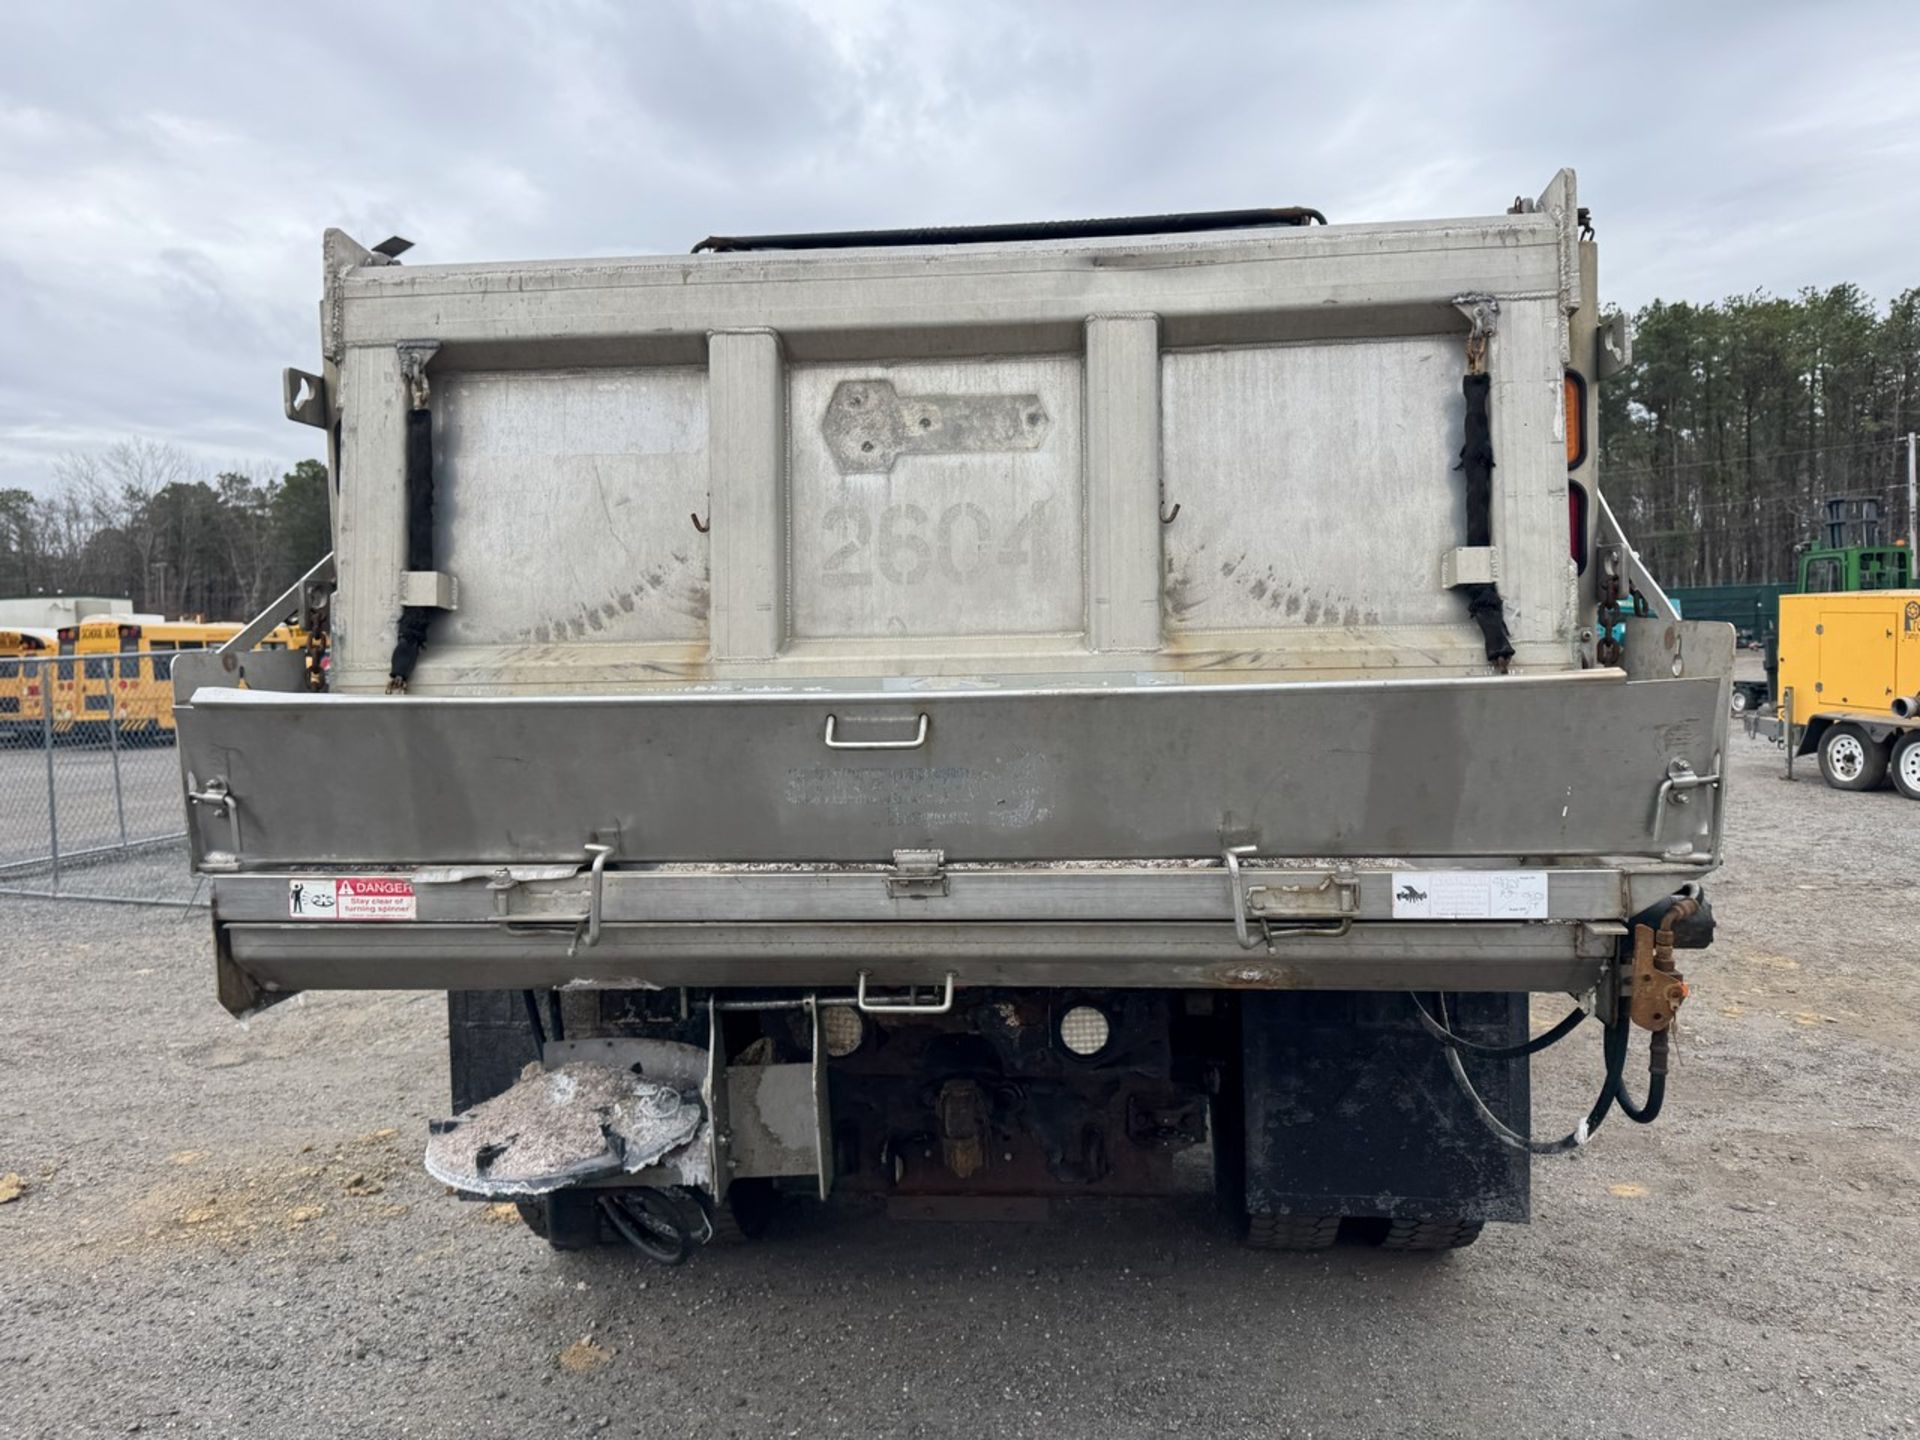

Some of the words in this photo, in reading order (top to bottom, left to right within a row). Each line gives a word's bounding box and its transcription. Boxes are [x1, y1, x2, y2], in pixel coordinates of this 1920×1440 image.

[821, 502, 1051, 588] 2604
[355, 882, 414, 894] DANGER
[344, 905, 376, 913] turning
